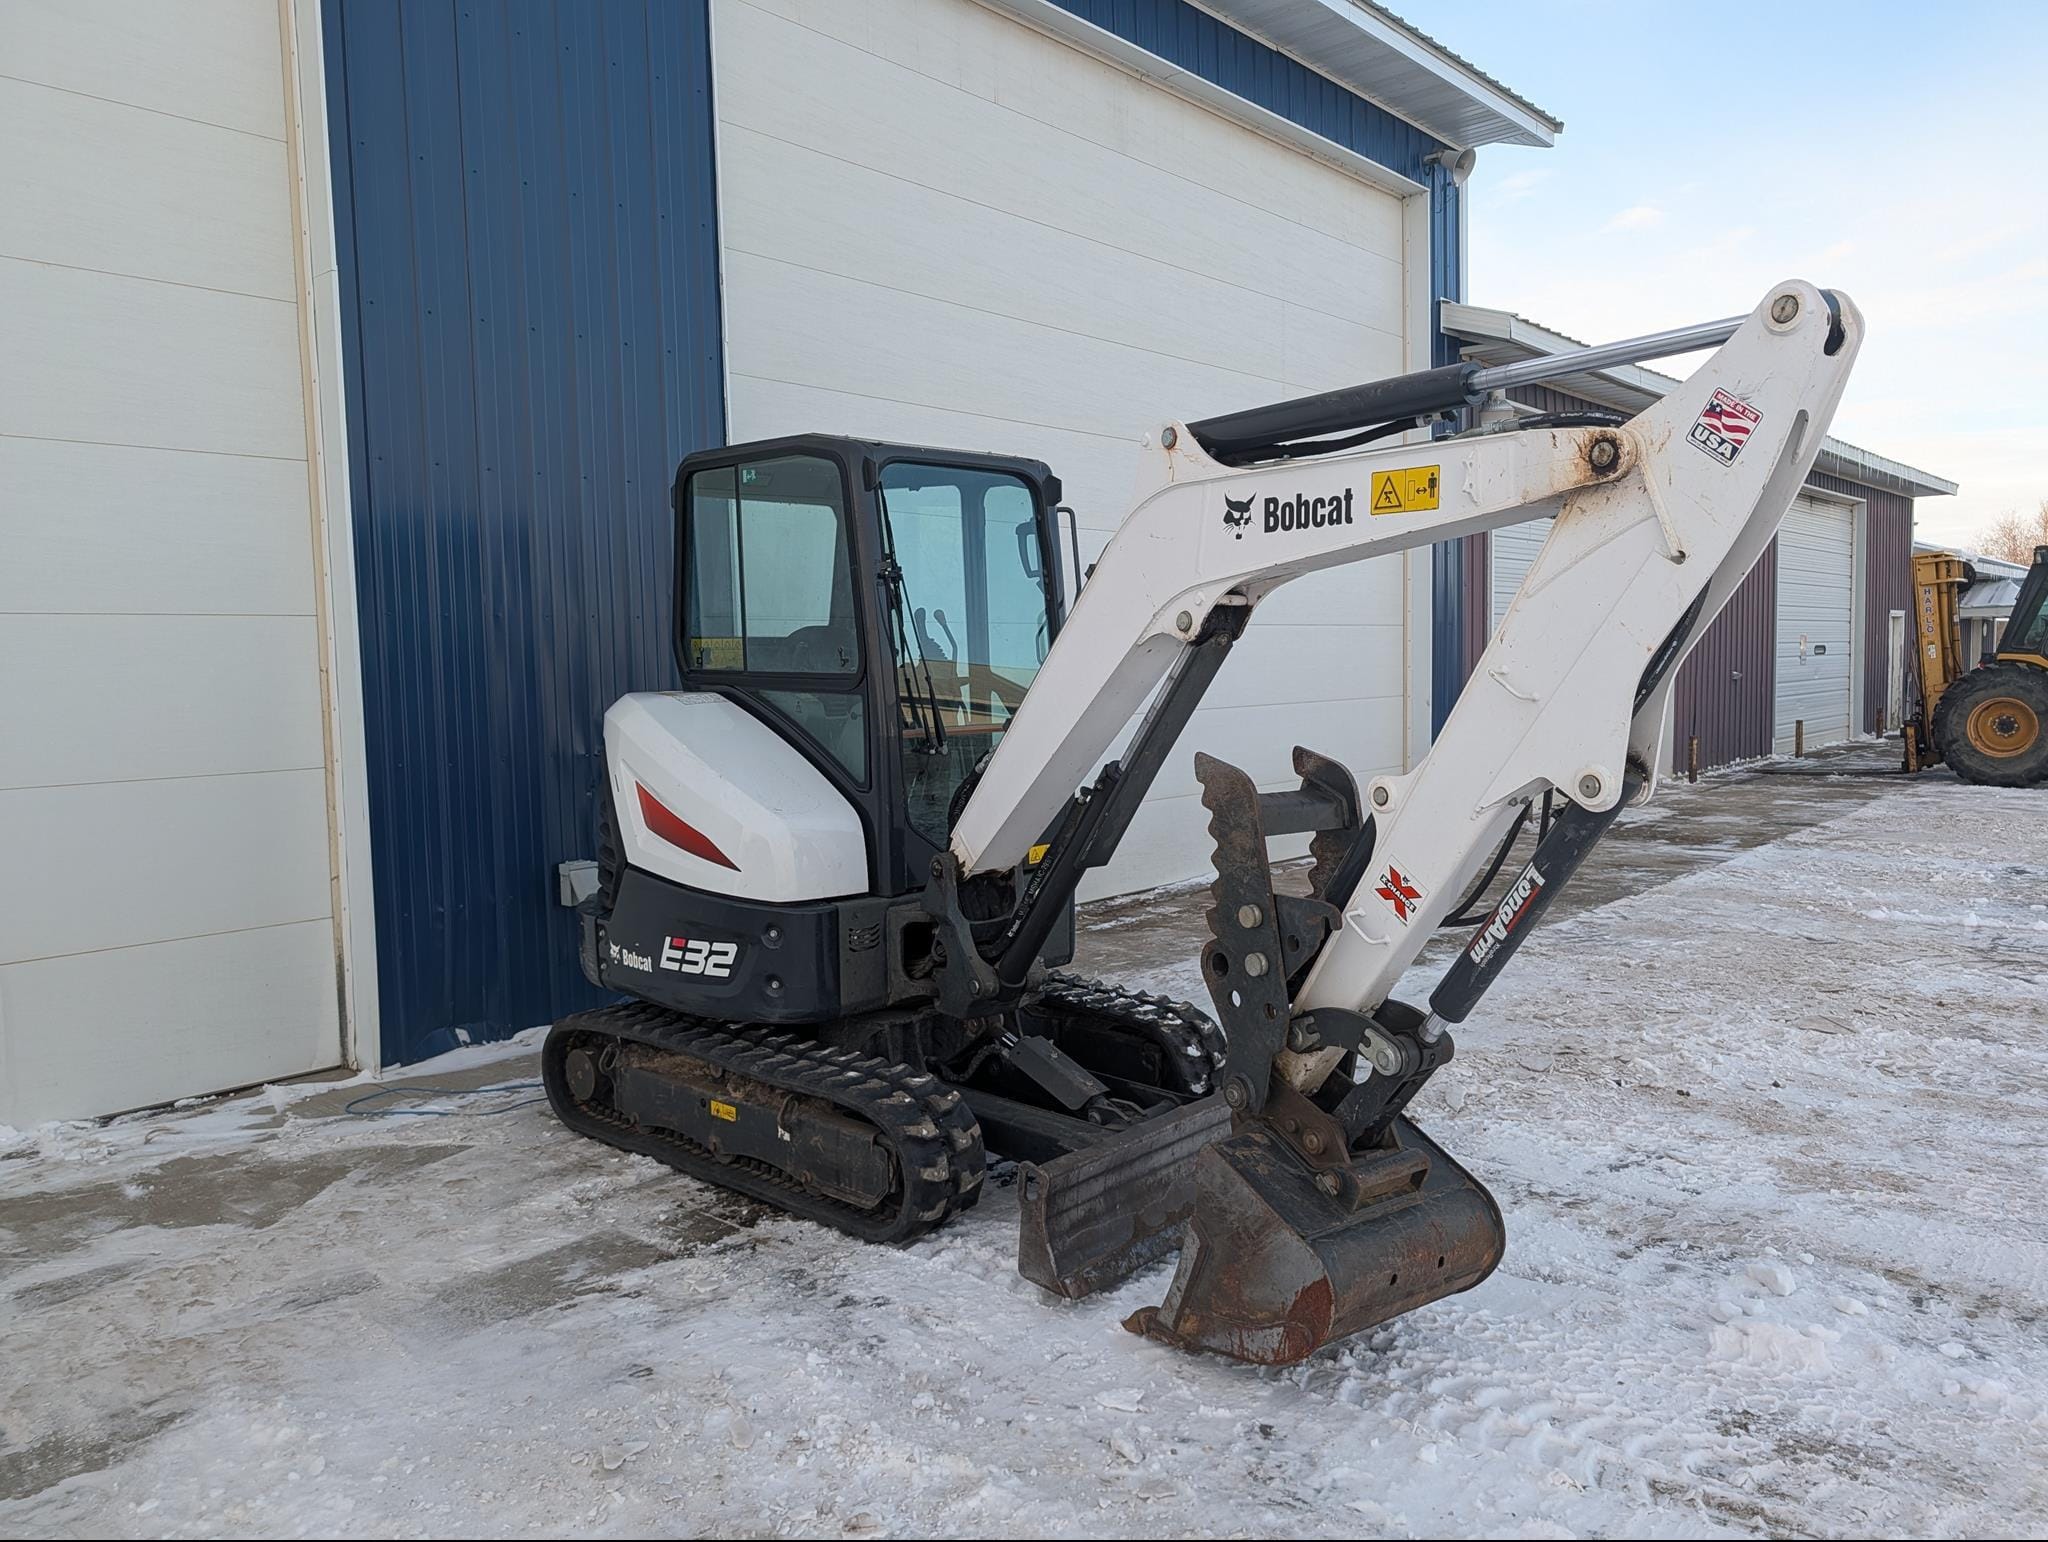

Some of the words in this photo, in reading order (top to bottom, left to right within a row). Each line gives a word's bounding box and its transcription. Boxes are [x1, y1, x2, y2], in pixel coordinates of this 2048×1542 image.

[1716, 393, 1737, 407] MADE
[1743, 409, 1757, 420] THE
[1694, 426, 1733, 459] USA
[1263, 487, 1354, 533] Bobcat
[1924, 588, 1934, 633] HARLO
[1381, 875, 1416, 912] X-CHANGE
[622, 948, 653, 973] Bobcat
[660, 936, 738, 977] E32
